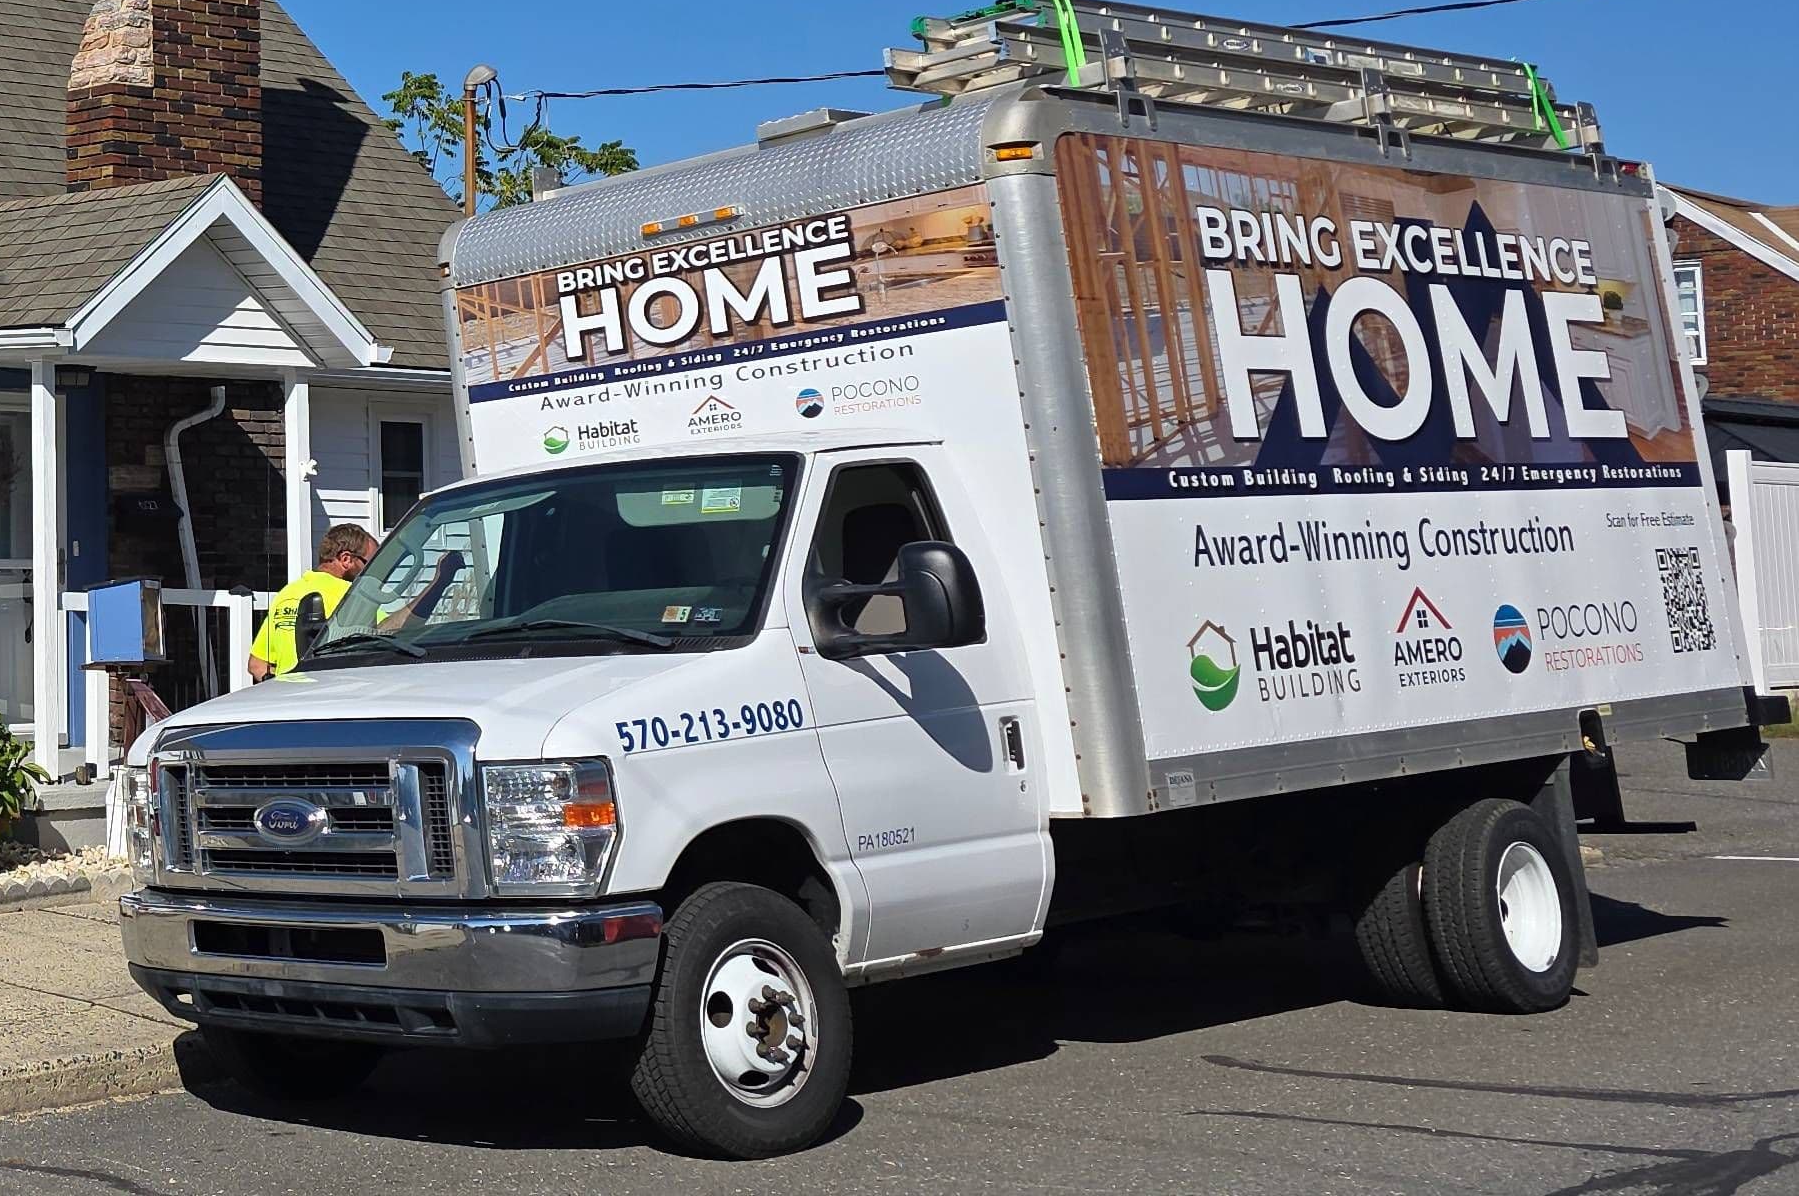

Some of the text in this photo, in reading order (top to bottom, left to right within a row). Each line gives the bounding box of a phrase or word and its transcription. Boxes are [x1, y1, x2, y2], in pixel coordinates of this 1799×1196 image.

[557, 215, 849, 293] BRING EXCELLENCE
[1196, 205, 1597, 286] BRING EXCELLENCE
[559, 241, 860, 359] HOME
[508, 379, 549, 392] Custom
[554, 370, 605, 386] Building
[614, 361, 662, 377] Roofing
[680, 352, 722, 367] Siding
[733, 344, 764, 357] 24/7
[770, 332, 845, 352] Emergency
[851, 315, 946, 339] Restorations
[1205, 268, 1629, 442] HOME
[540, 343, 914, 411] Award-Winning Construction
[831, 375, 920, 402] POCONO
[687, 411, 742, 428] AMERO
[833, 394, 922, 416] RESTORATIONS
[577, 418, 639, 441] Habitat
[579, 434, 641, 451] BUILDING
[690, 422, 743, 435] EXTERIORS
[1168, 464, 1682, 489] Custom Building Roofing & Siding 24/7 Emergency Restorations
[1606, 512, 1695, 528] Scan for Free Estimate
[1194, 516, 1575, 571] Award-Winning Construction
[1536, 600, 1638, 640] POCONO
[1249, 619, 1356, 671] Habitat
[1394, 636, 1463, 667] AMERO
[1544, 642, 1644, 672] RESTORATIONS
[1257, 668, 1361, 702] BUILDING
[1399, 667, 1466, 687] EXTERIORS
[615, 698, 803, 752] 570-213-9080
[858, 826, 916, 852] PA180521
